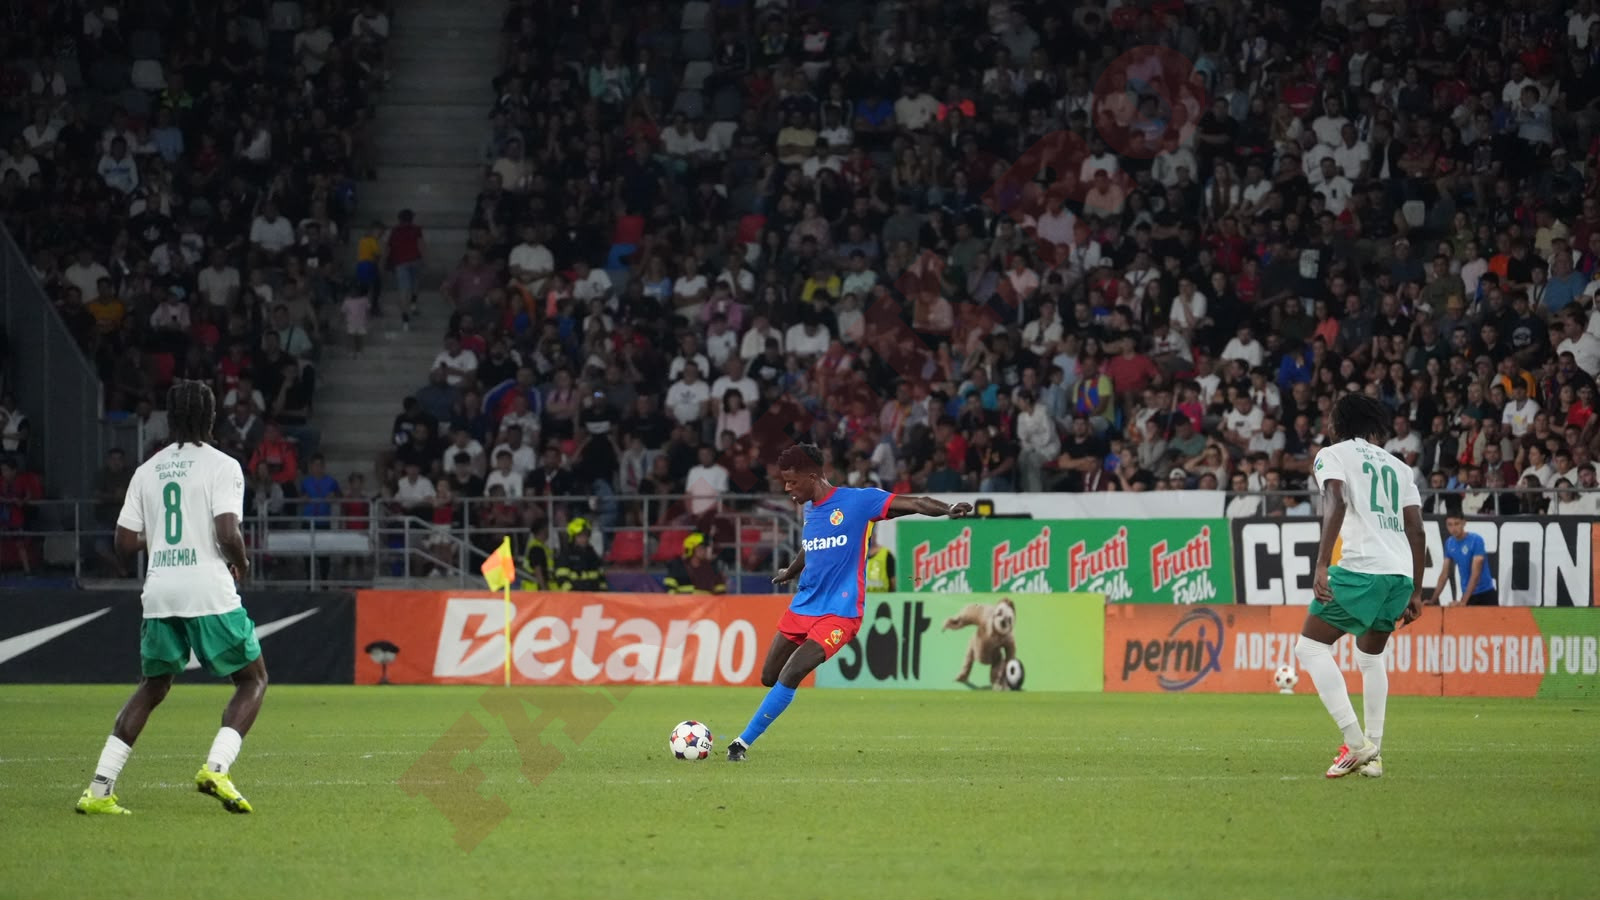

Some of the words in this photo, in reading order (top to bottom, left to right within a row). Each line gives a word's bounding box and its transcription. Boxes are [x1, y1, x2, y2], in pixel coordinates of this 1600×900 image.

[155, 460, 195, 472] SIGNET
[159, 470, 188, 480] BANK
[1362, 461, 1399, 515] 20
[163, 481, 182, 545] 8
[802, 535, 848, 552] Betano
[913, 526, 972, 592] Frutti
[992, 526, 1051, 592] Frutti
[1068, 525, 1128, 592] Frutti
[1151, 525, 1212, 592] Frutti
[1088, 570, 1133, 601] Fesh
[1171, 570, 1216, 605] Fresh
[433, 597, 757, 684] Betano
[1122, 624, 1221, 681] pernix
[1234, 632, 1308, 671] ADEZI
[1416, 634, 1545, 674] INDUSTRIA
[1550, 635, 1600, 675] PUB
